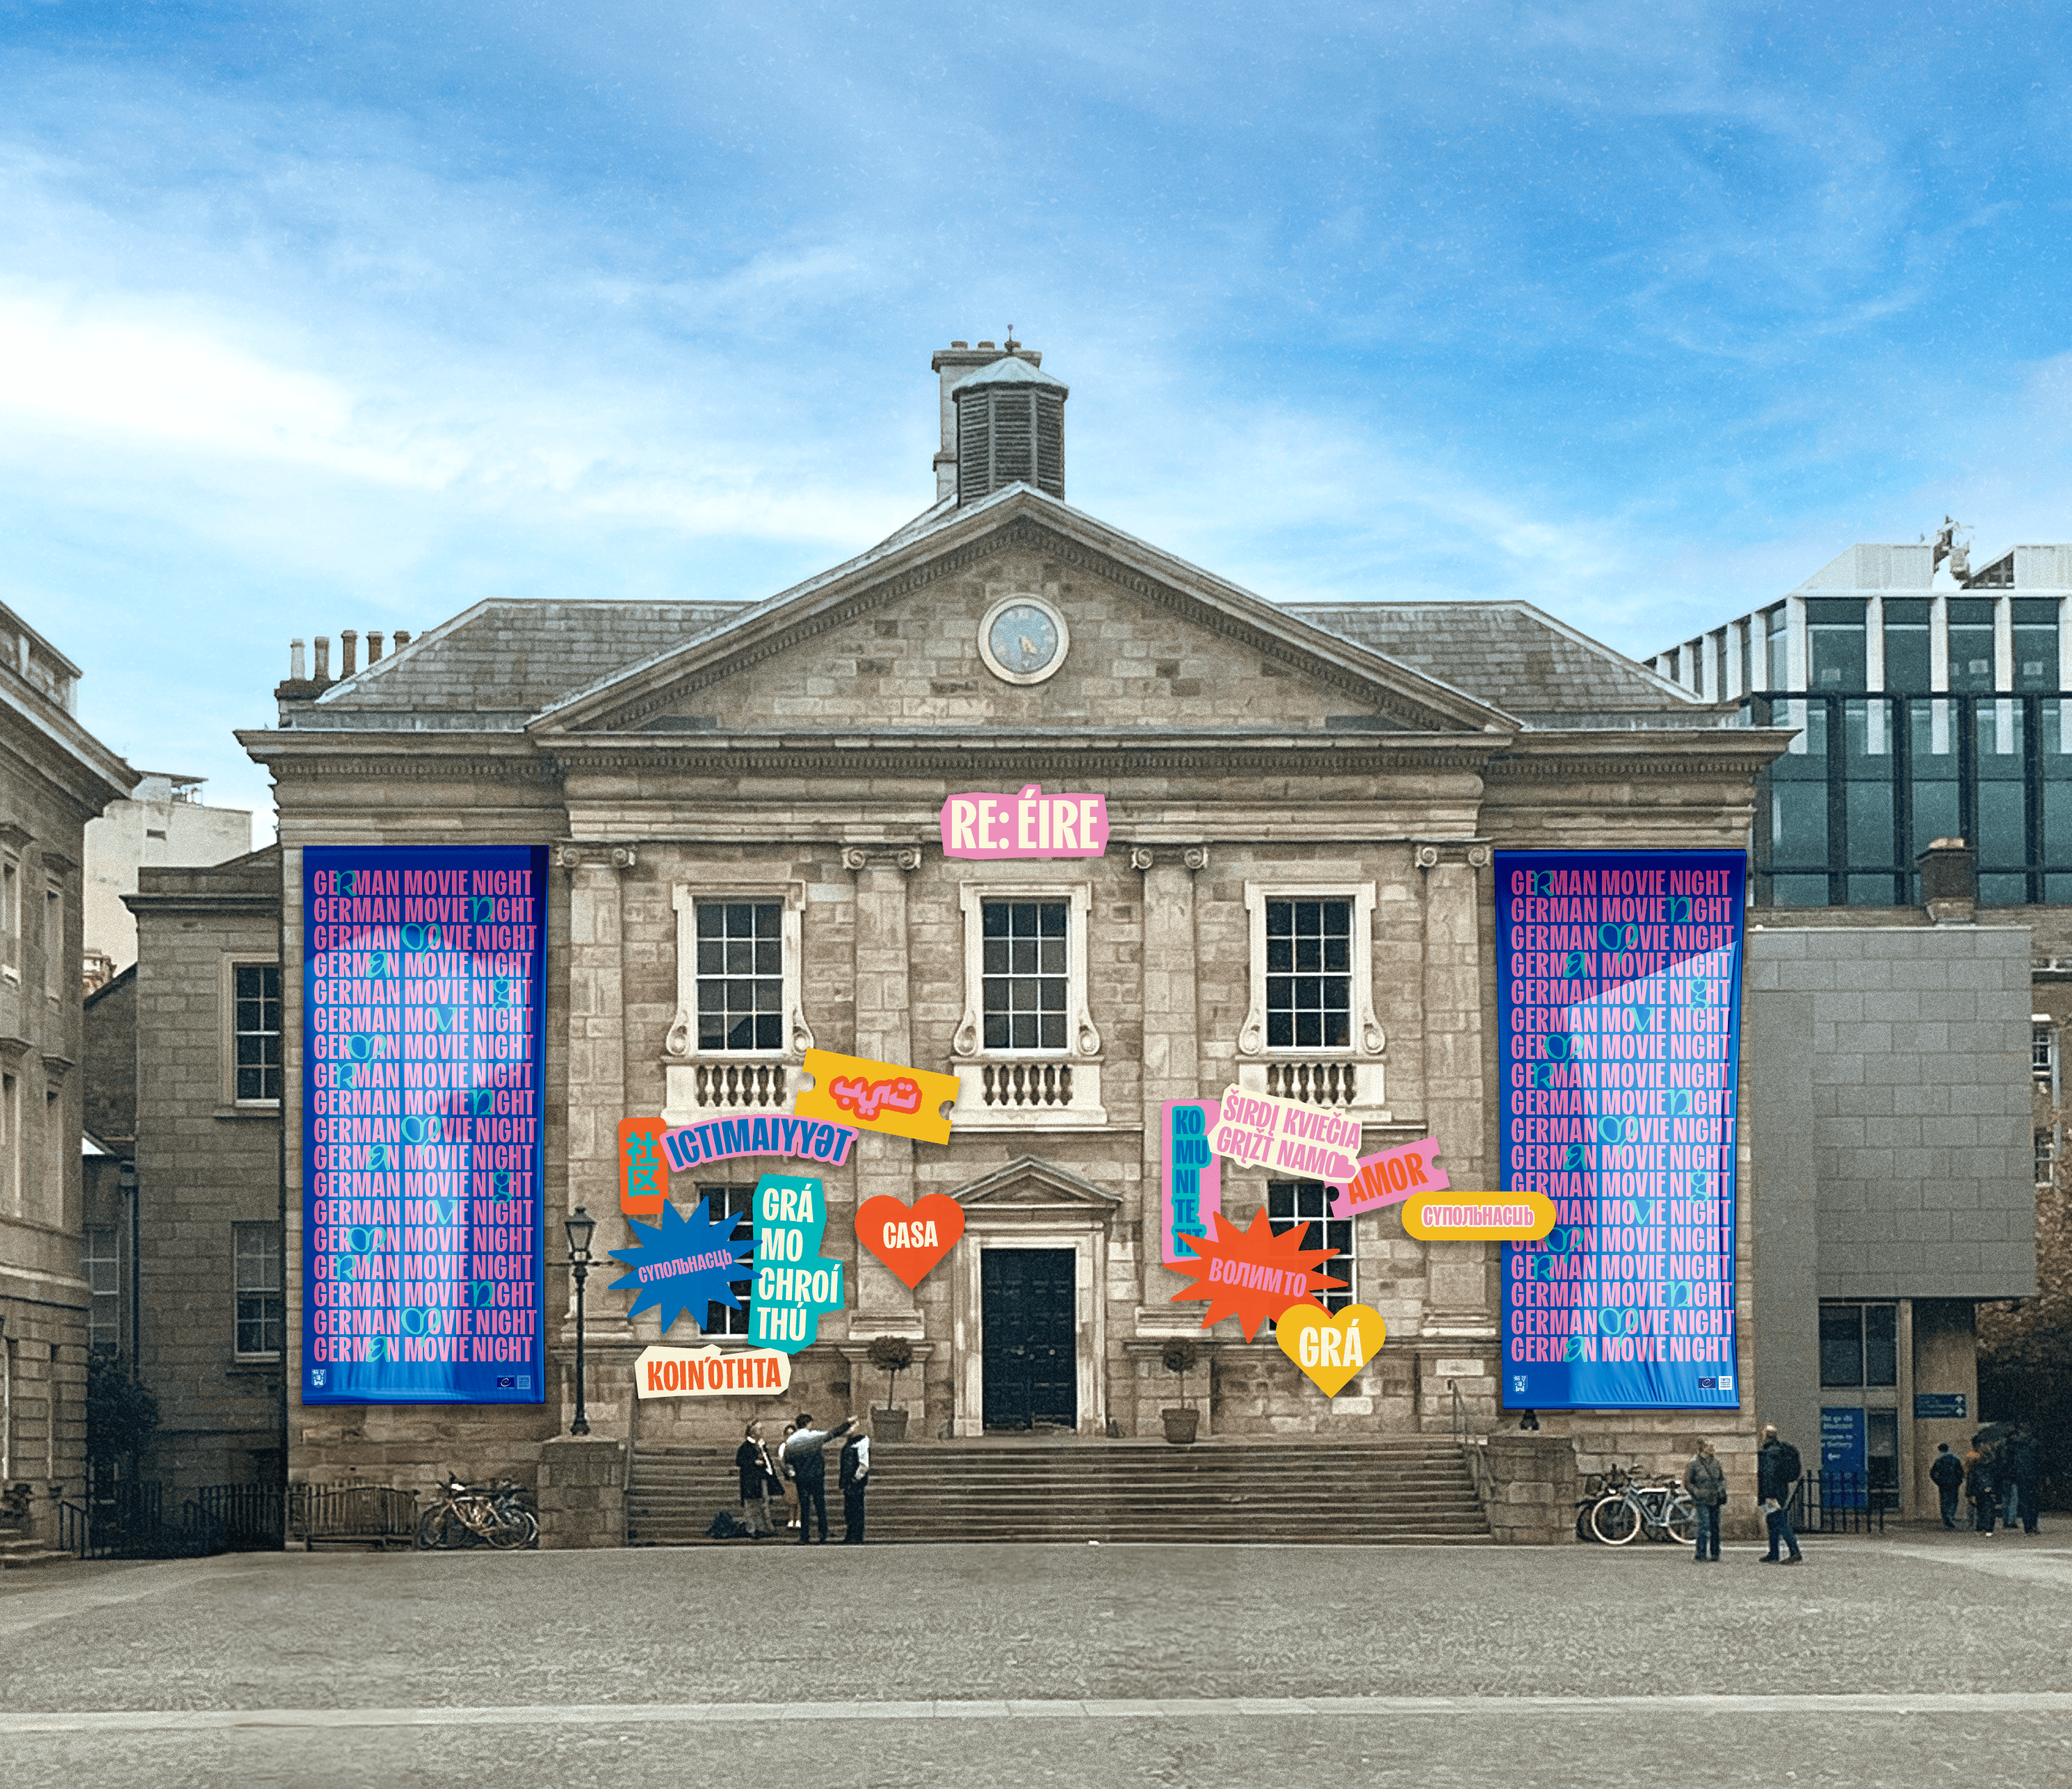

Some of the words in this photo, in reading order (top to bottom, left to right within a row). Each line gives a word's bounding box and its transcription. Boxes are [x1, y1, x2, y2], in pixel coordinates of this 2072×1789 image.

[952, 800, 1010, 849] RE:
[1019, 789, 1099, 848] ÉIRE
[405, 871, 469, 895] MOVIE
[474, 871, 531, 895] NIGHT
[1603, 871, 1666, 895] MOVIE
[1671, 871, 1730, 895] NIGHT
[314, 898, 399, 922] GERMAN
[405, 898, 469, 922] MOVIE
[1512, 898, 1596, 922] GERMAN
[1603, 898, 1666, 922] MOVIE
[314, 925, 399, 950] GERMAN
[477, 925, 537, 950] NIGHT
[1512, 925, 1596, 950] GERMAN
[1674, 925, 1734, 950] NIGHT
[405, 953, 469, 977] MOVIE
[474, 953, 533, 977] NIGHT
[1603, 953, 1666, 977] MOVIE
[1671, 953, 1730, 977] NIGHT
[314, 980, 399, 1004] GERMAN
[405, 980, 469, 1004] MOVIE
[1512, 980, 1596, 1004] GERMAN
[1603, 980, 1666, 1004] MOVIE
[314, 1007, 399, 1032] GERMAN
[474, 1007, 533, 1032] NIGHT
[1512, 1007, 1596, 1032] GERMAN
[1671, 1007, 1730, 1032] NIGHT
[405, 1035, 469, 1059] MOVIE
[474, 1035, 533, 1059] NIGHT
[1603, 1035, 1666, 1059] MOVIE
[1671, 1035, 1730, 1059] NIGHT
[405, 1063, 469, 1087] MOVIE
[474, 1063, 533, 1087] NIGHT
[1603, 1063, 1666, 1087] MOVIE
[1671, 1063, 1730, 1087] NIGHT
[314, 1090, 399, 1115] GERMAN
[405, 1090, 469, 1115] MOVIE
[1512, 1090, 1596, 1115] GERMAN
[1603, 1090, 1666, 1115] MOVIE
[314, 1118, 399, 1142] GERMAN
[477, 1118, 537, 1142] NIGHT
[1176, 1110, 1201, 1134] KO
[1224, 1088, 1280, 1137] ŠIRDĮ
[1283, 1108, 1360, 1150] KVIEČIA
[1512, 1118, 1596, 1142] GERMAN
[1674, 1118, 1734, 1142] NIGHT
[405, 1145, 469, 1169] MOVIE
[474, 1145, 533, 1169] NIGHT
[1176, 1140, 1208, 1164] MU
[1217, 1126, 1274, 1164] GRĮŽT
[1277, 1140, 1341, 1178] NAMO
[1603, 1145, 1666, 1169] MOVIE
[1671, 1145, 1730, 1169] NIGHT
[626, 1132, 660, 1197] 社区
[314, 1172, 399, 1197] GERMAN
[405, 1172, 469, 1197] MOVIE
[1176, 1169, 1196, 1193] NI
[1350, 1153, 1428, 1204] AMOR
[1512, 1172, 1596, 1197] GERMAN
[1603, 1172, 1666, 1197] MOVIE
[314, 1200, 399, 1224] GERMAN
[474, 1200, 533, 1224] NIGHT
[763, 1183, 814, 1223] GRÁ
[1175, 1199, 1195, 1223] TE
[1671, 1200, 1730, 1224] NIGHT
[405, 1227, 469, 1252] MOVIE
[474, 1227, 533, 1252] NIGHT
[760, 1228, 803, 1262] MO
[883, 1221, 939, 1249] CASA
[1603, 1227, 1666, 1252] MOVIE
[1671, 1227, 1730, 1252] NIGHT
[405, 1255, 469, 1279] MOVIE
[474, 1255, 533, 1279] NIGHT
[1603, 1255, 1666, 1279] MOVIE
[1671, 1255, 1730, 1279] NIGHT
[314, 1282, 399, 1306] GERMAN
[405, 1282, 469, 1306] MOVIE
[758, 1264, 841, 1304] CHROÍ
[1512, 1282, 1596, 1306] GERMAN
[1603, 1282, 1666, 1306] MOVIE
[314, 1310, 399, 1334] GERMAN
[477, 1310, 537, 1334] NIGHT
[757, 1302, 807, 1341] THÚ
[1512, 1310, 1596, 1334] GERMAN
[1674, 1310, 1734, 1334] NIGHT
[405, 1337, 469, 1361] MOVIE
[474, 1337, 533, 1361] NIGHT
[1299, 1319, 1363, 1367] GRÁ
[1603, 1337, 1666, 1361] MOVIE
[1671, 1337, 1730, 1361] NIGHT
